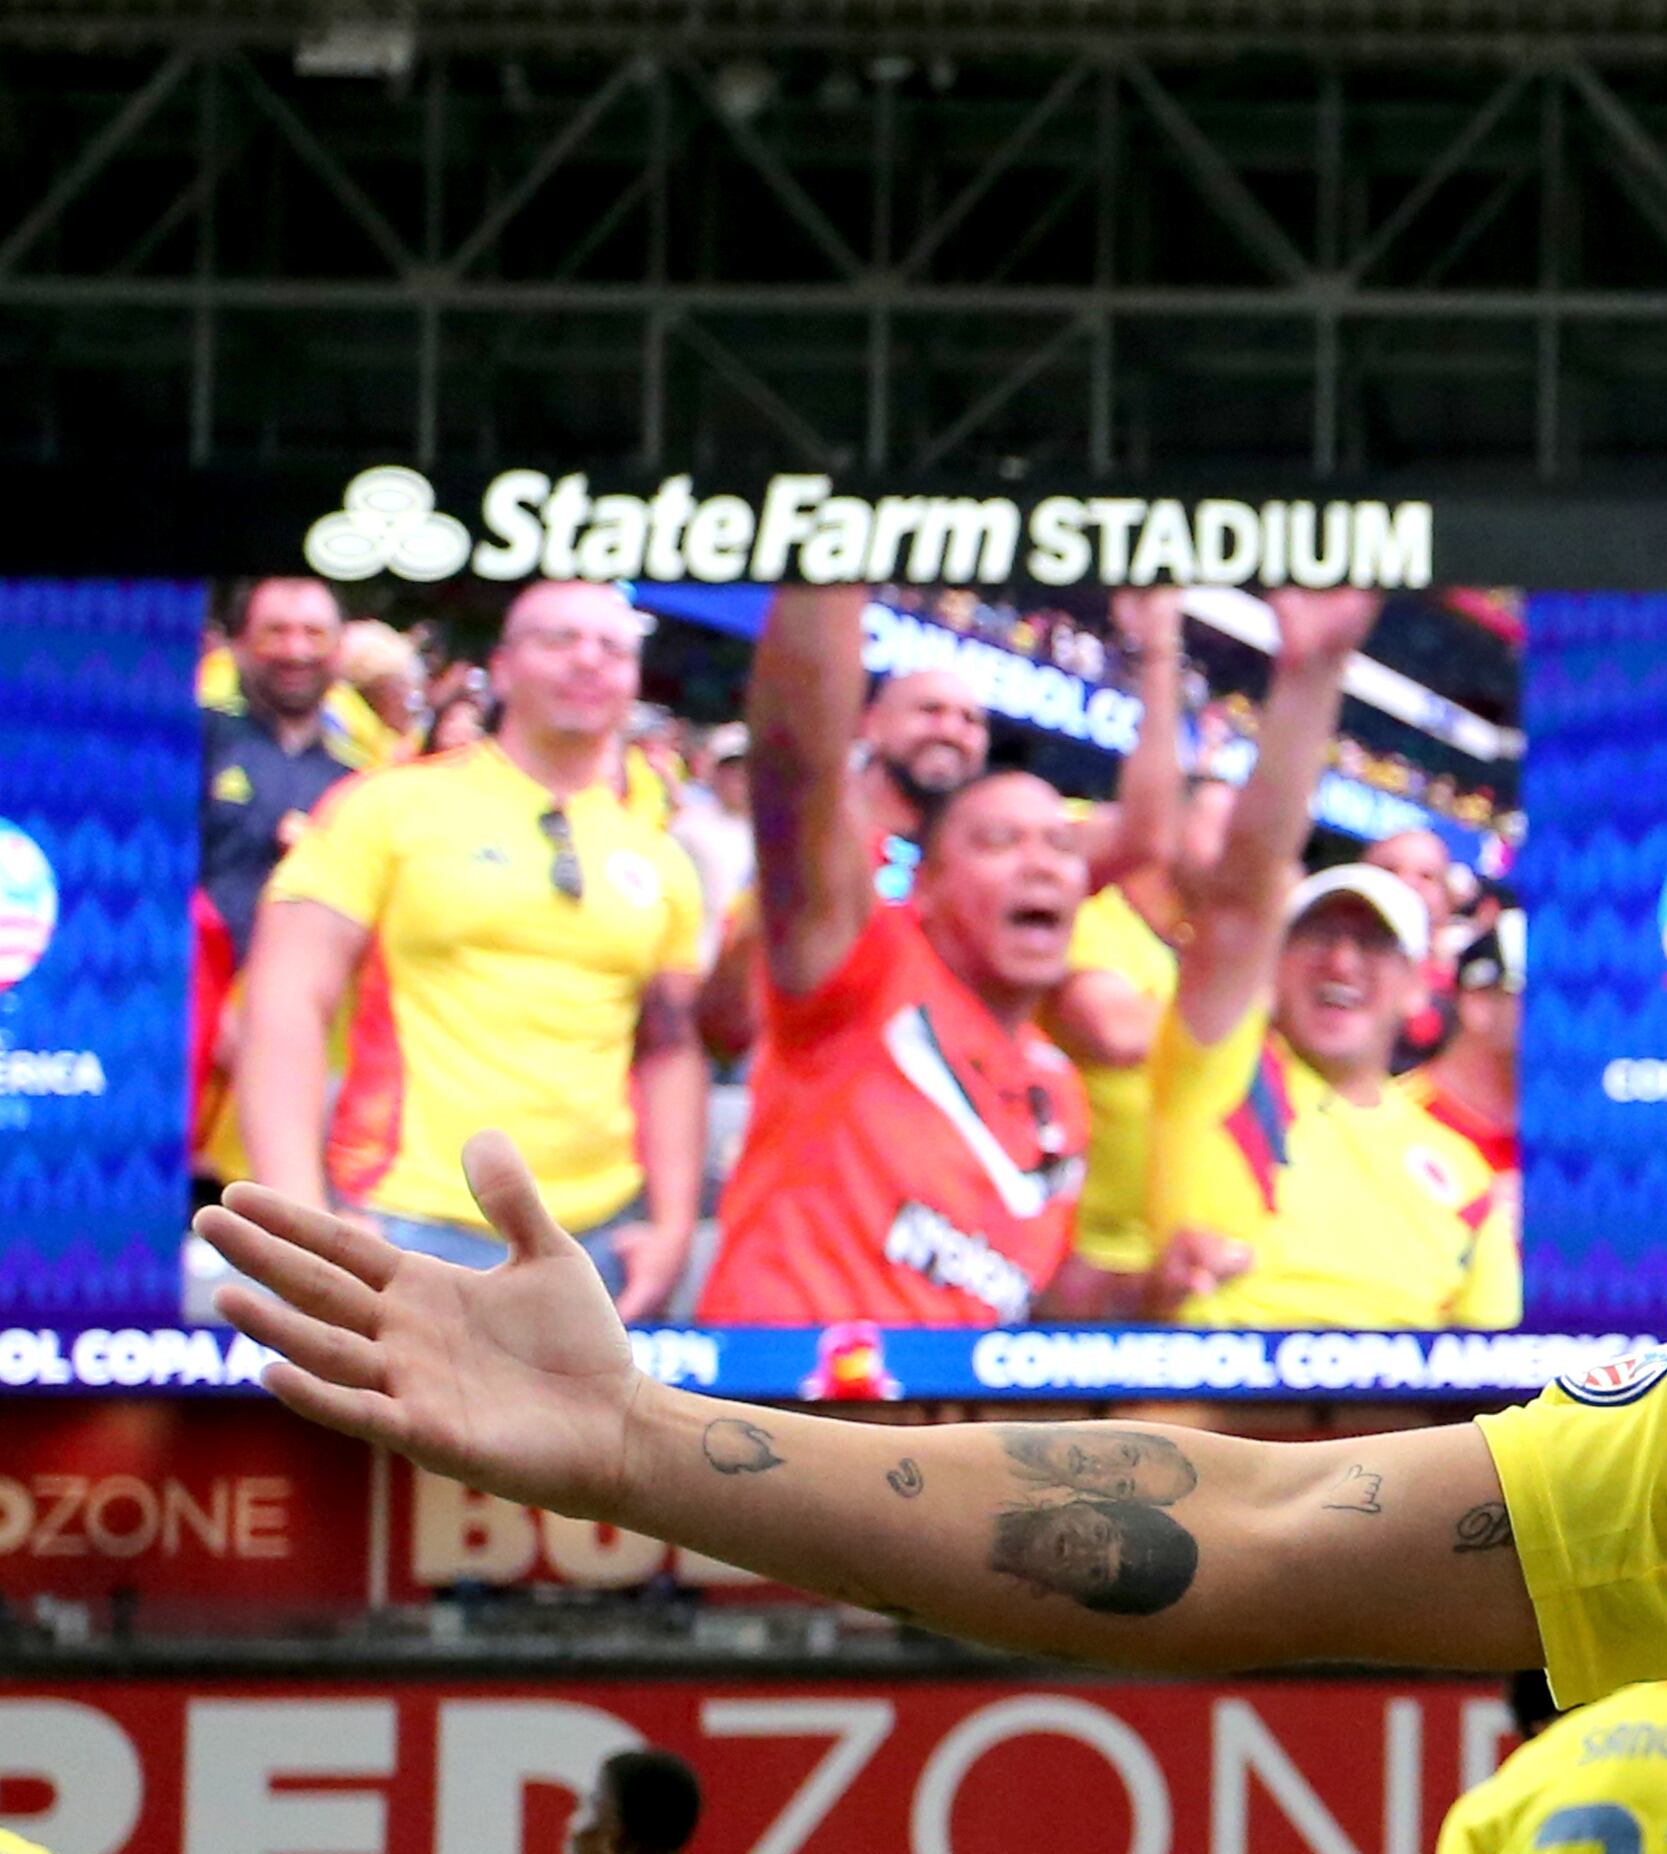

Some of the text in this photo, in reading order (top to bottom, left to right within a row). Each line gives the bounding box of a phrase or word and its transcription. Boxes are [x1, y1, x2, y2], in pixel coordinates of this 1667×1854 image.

[1028, 496, 1434, 591] STADIUM
[73, 1330, 224, 1386] COPA
[973, 1332, 1275, 1387] CONMEBOL
[1276, 1332, 1425, 1387] COPA
